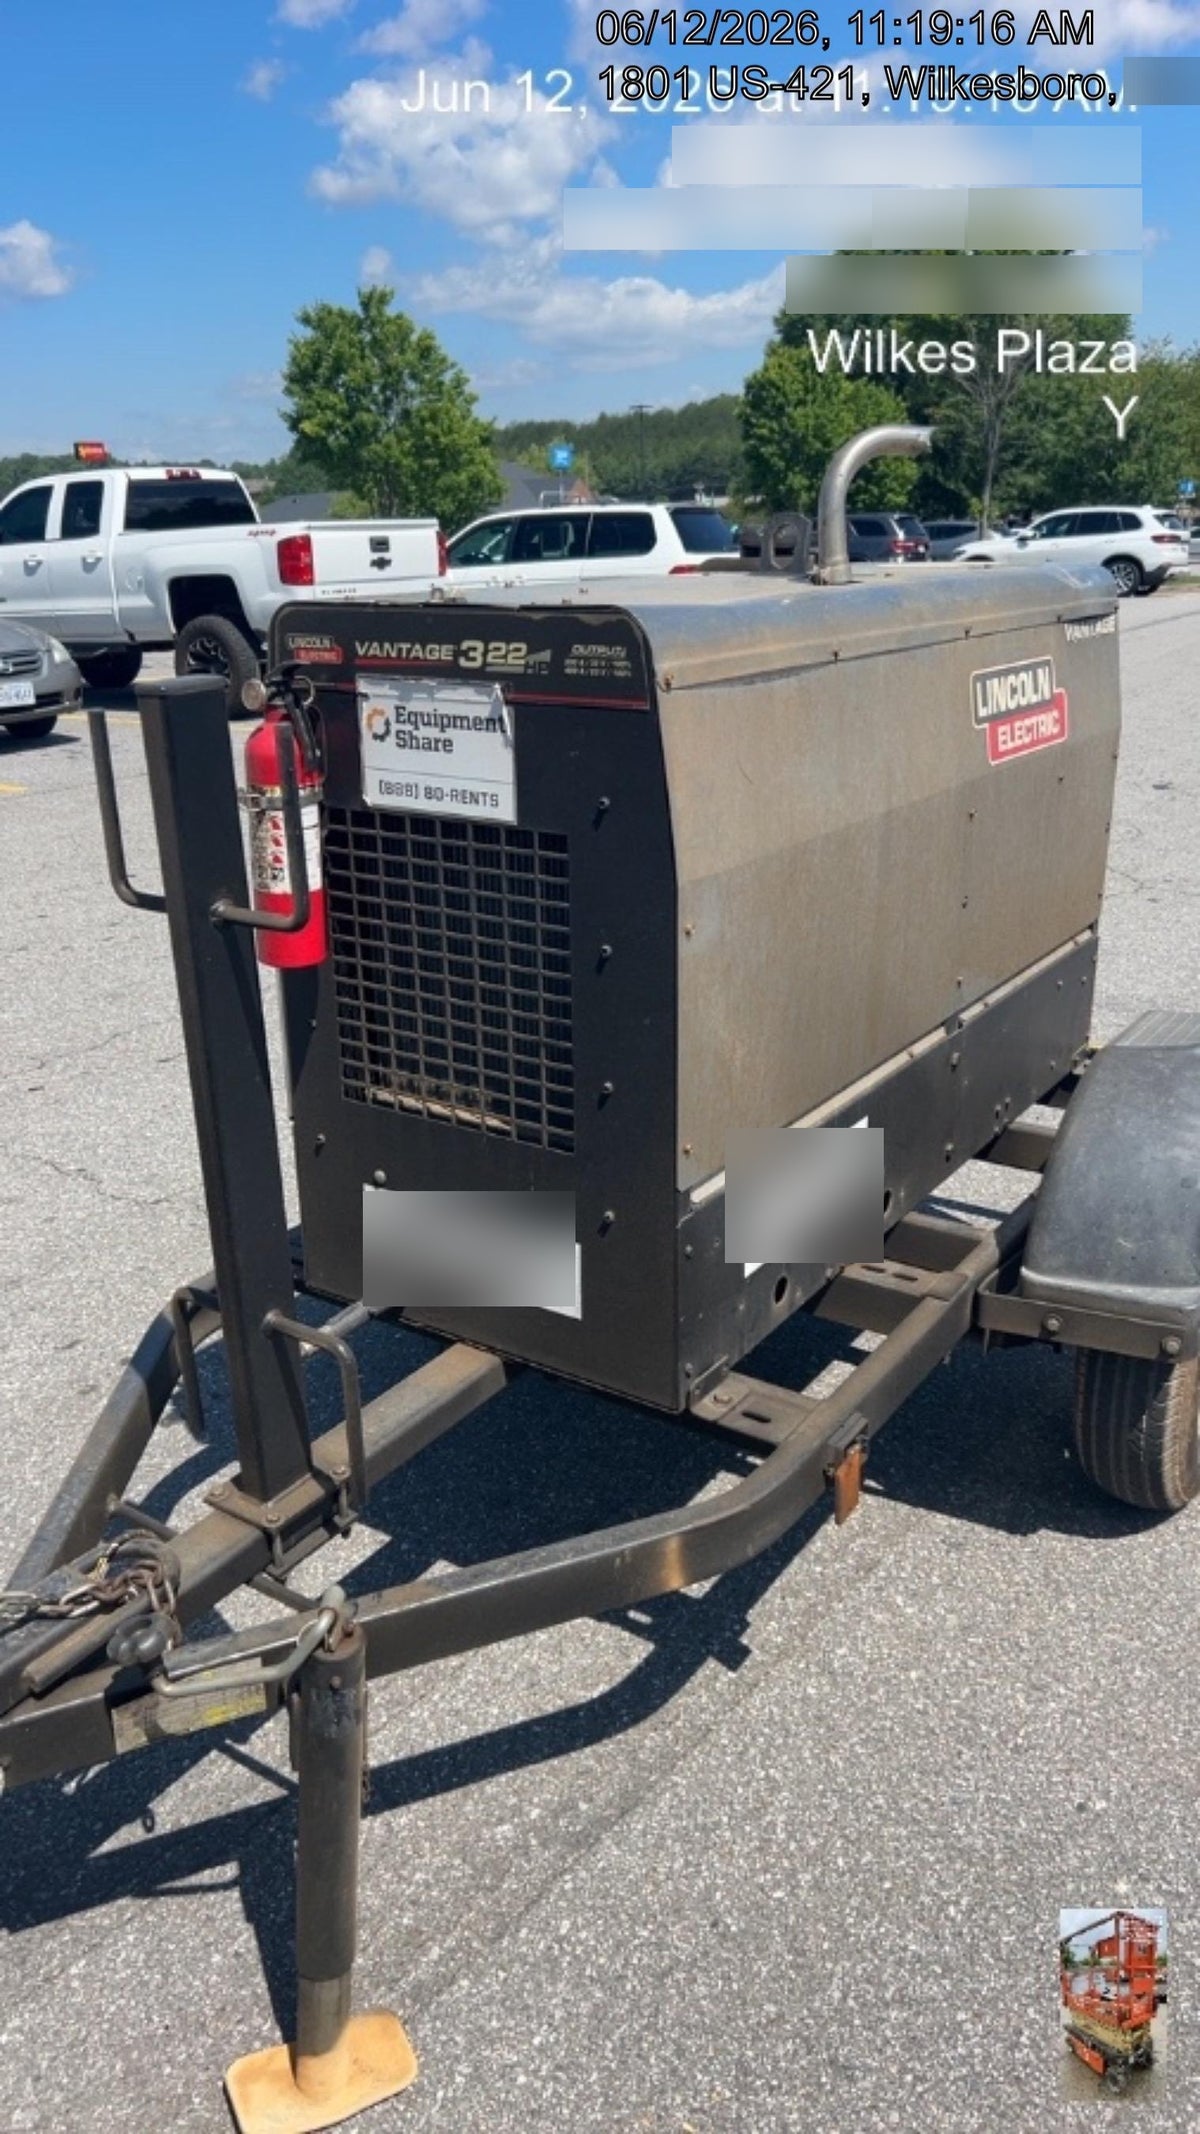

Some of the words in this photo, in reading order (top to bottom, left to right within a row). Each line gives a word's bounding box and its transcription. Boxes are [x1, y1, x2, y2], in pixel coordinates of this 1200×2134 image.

[354, 640, 455, 661] VANTAGE
[458, 639, 528, 668] 322
[976, 665, 1050, 718] LINCOLN
[394, 705, 507, 734] Equipment
[997, 710, 1060, 753] ELECTRIC
[395, 730, 454, 753] Share
